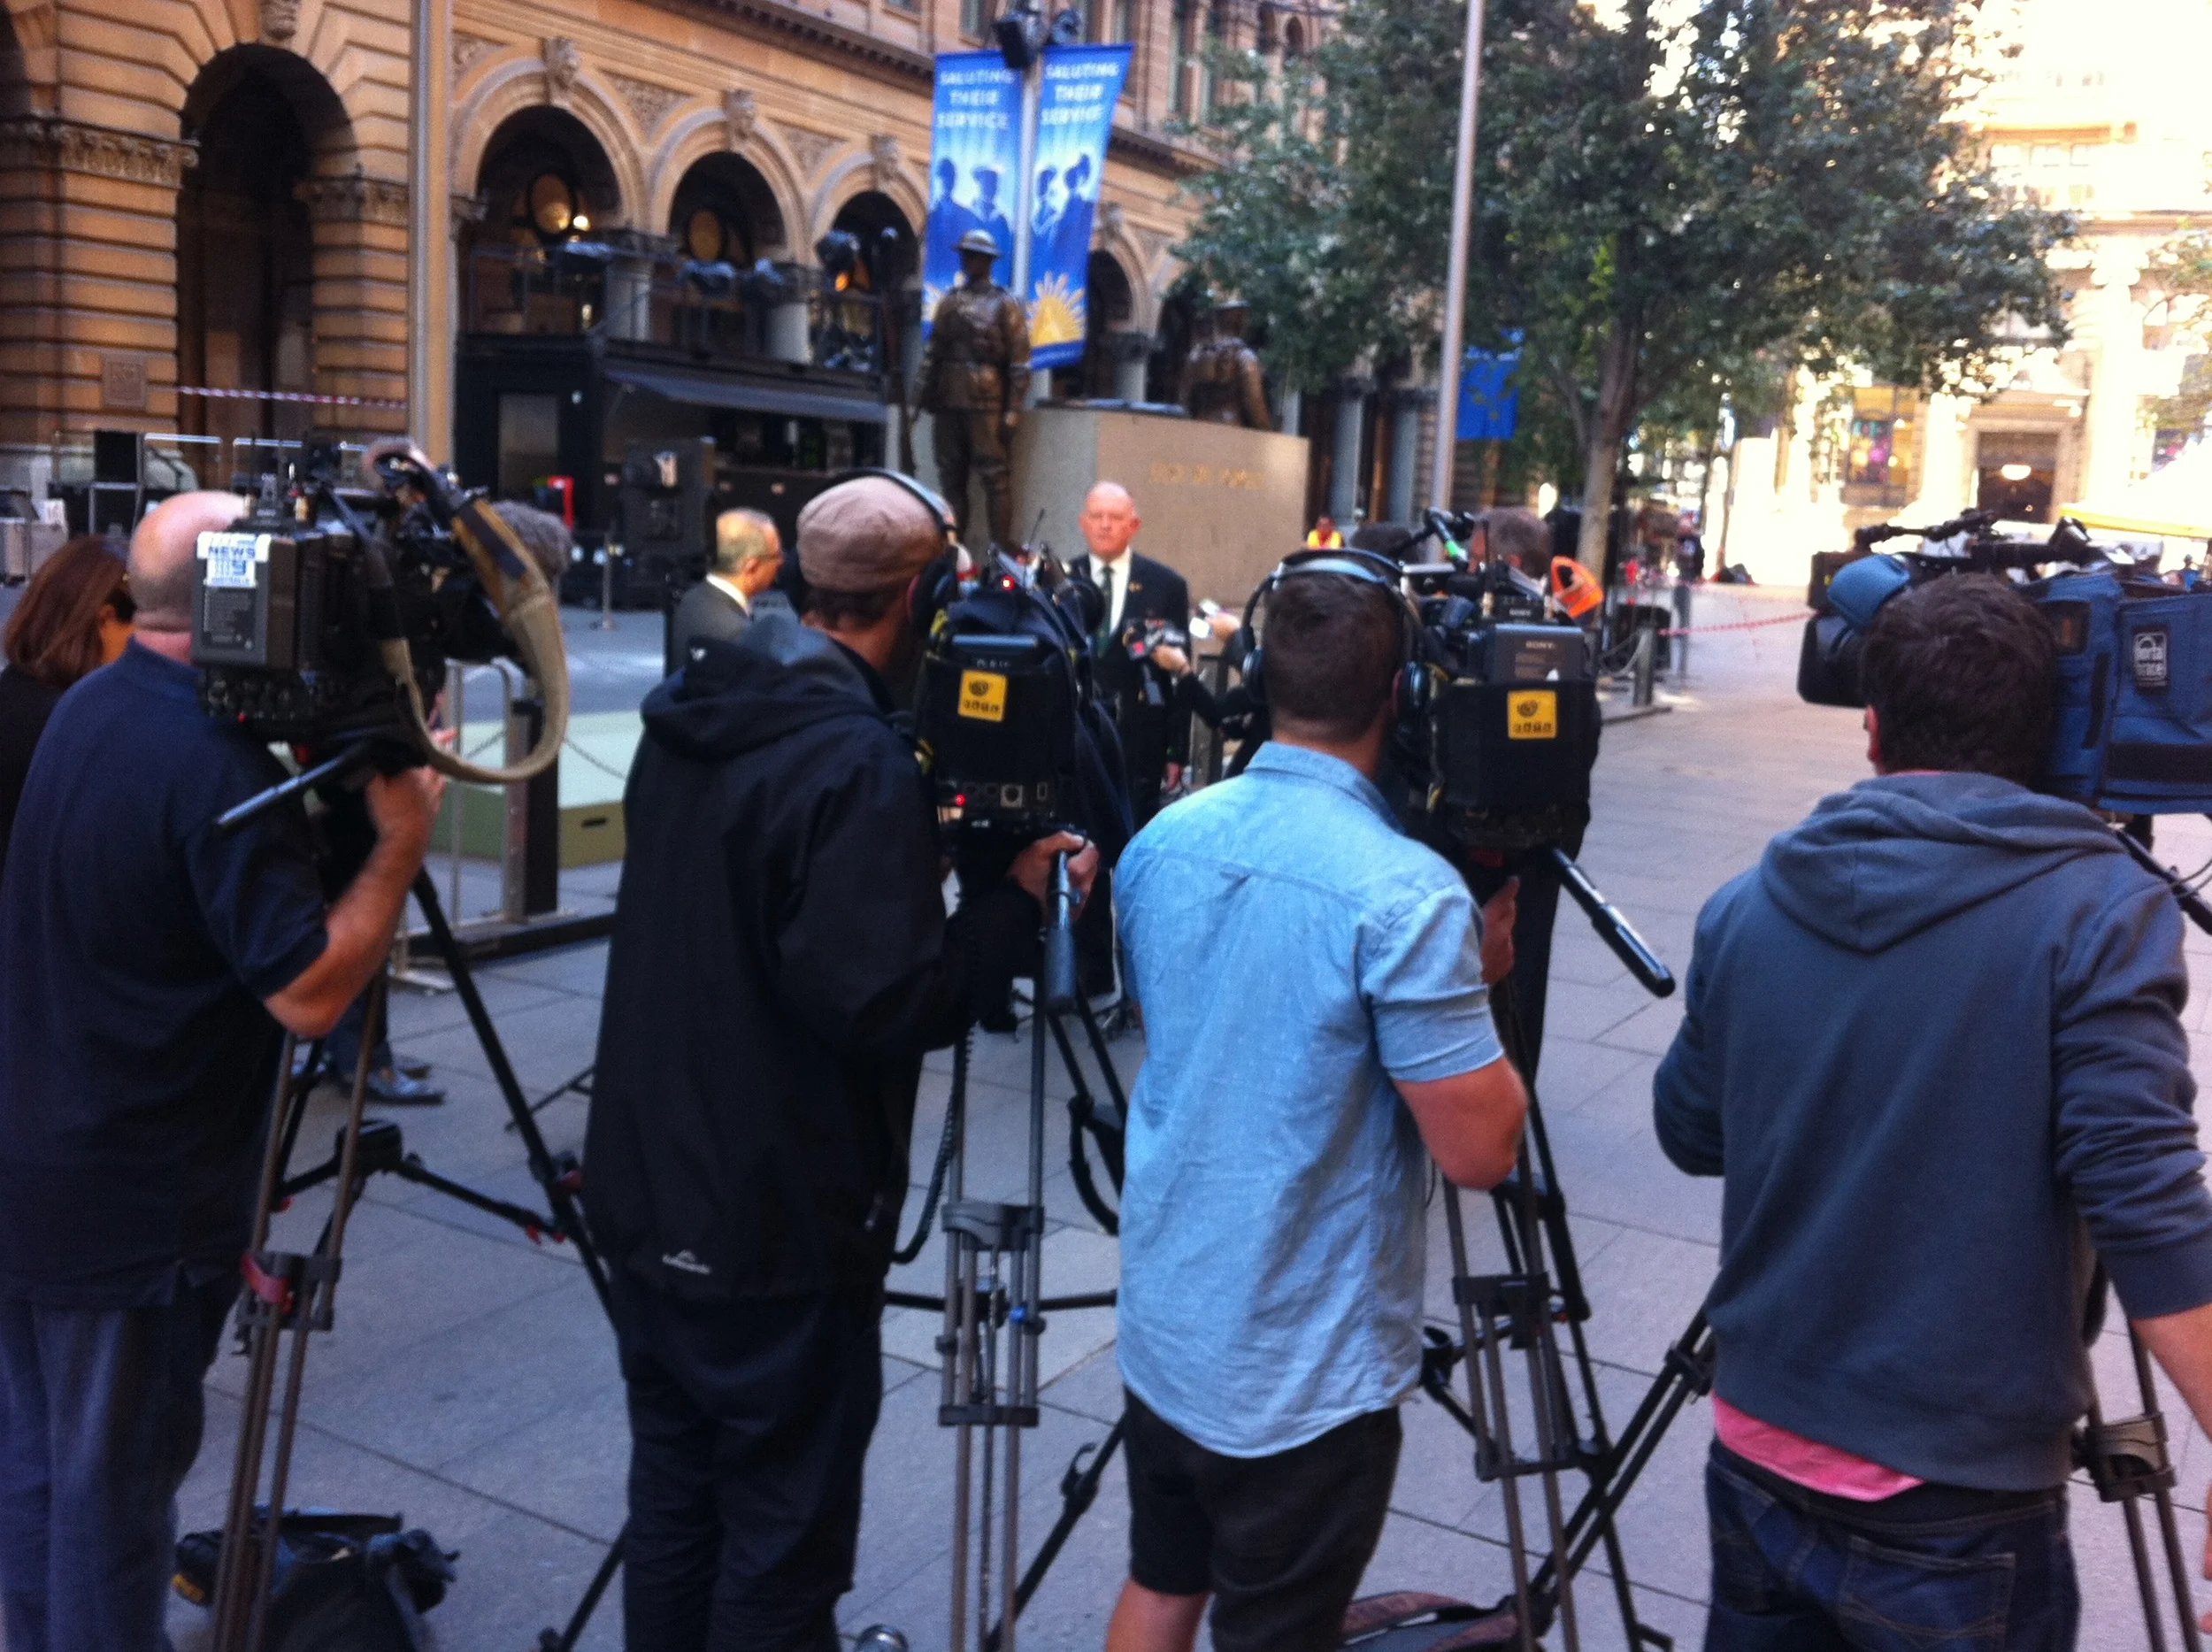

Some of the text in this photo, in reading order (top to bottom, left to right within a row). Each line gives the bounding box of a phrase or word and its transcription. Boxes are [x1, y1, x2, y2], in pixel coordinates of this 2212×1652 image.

[940, 68, 1015, 85] SALUTING
[1045, 62, 1119, 79] SALUTING
[949, 89, 999, 106] THEIR
[1055, 84, 1104, 102] THEIR
[936, 111, 1010, 129] SERVICE
[1041, 104, 1102, 126] SERVICE
[208, 545, 256, 559] NEWS
